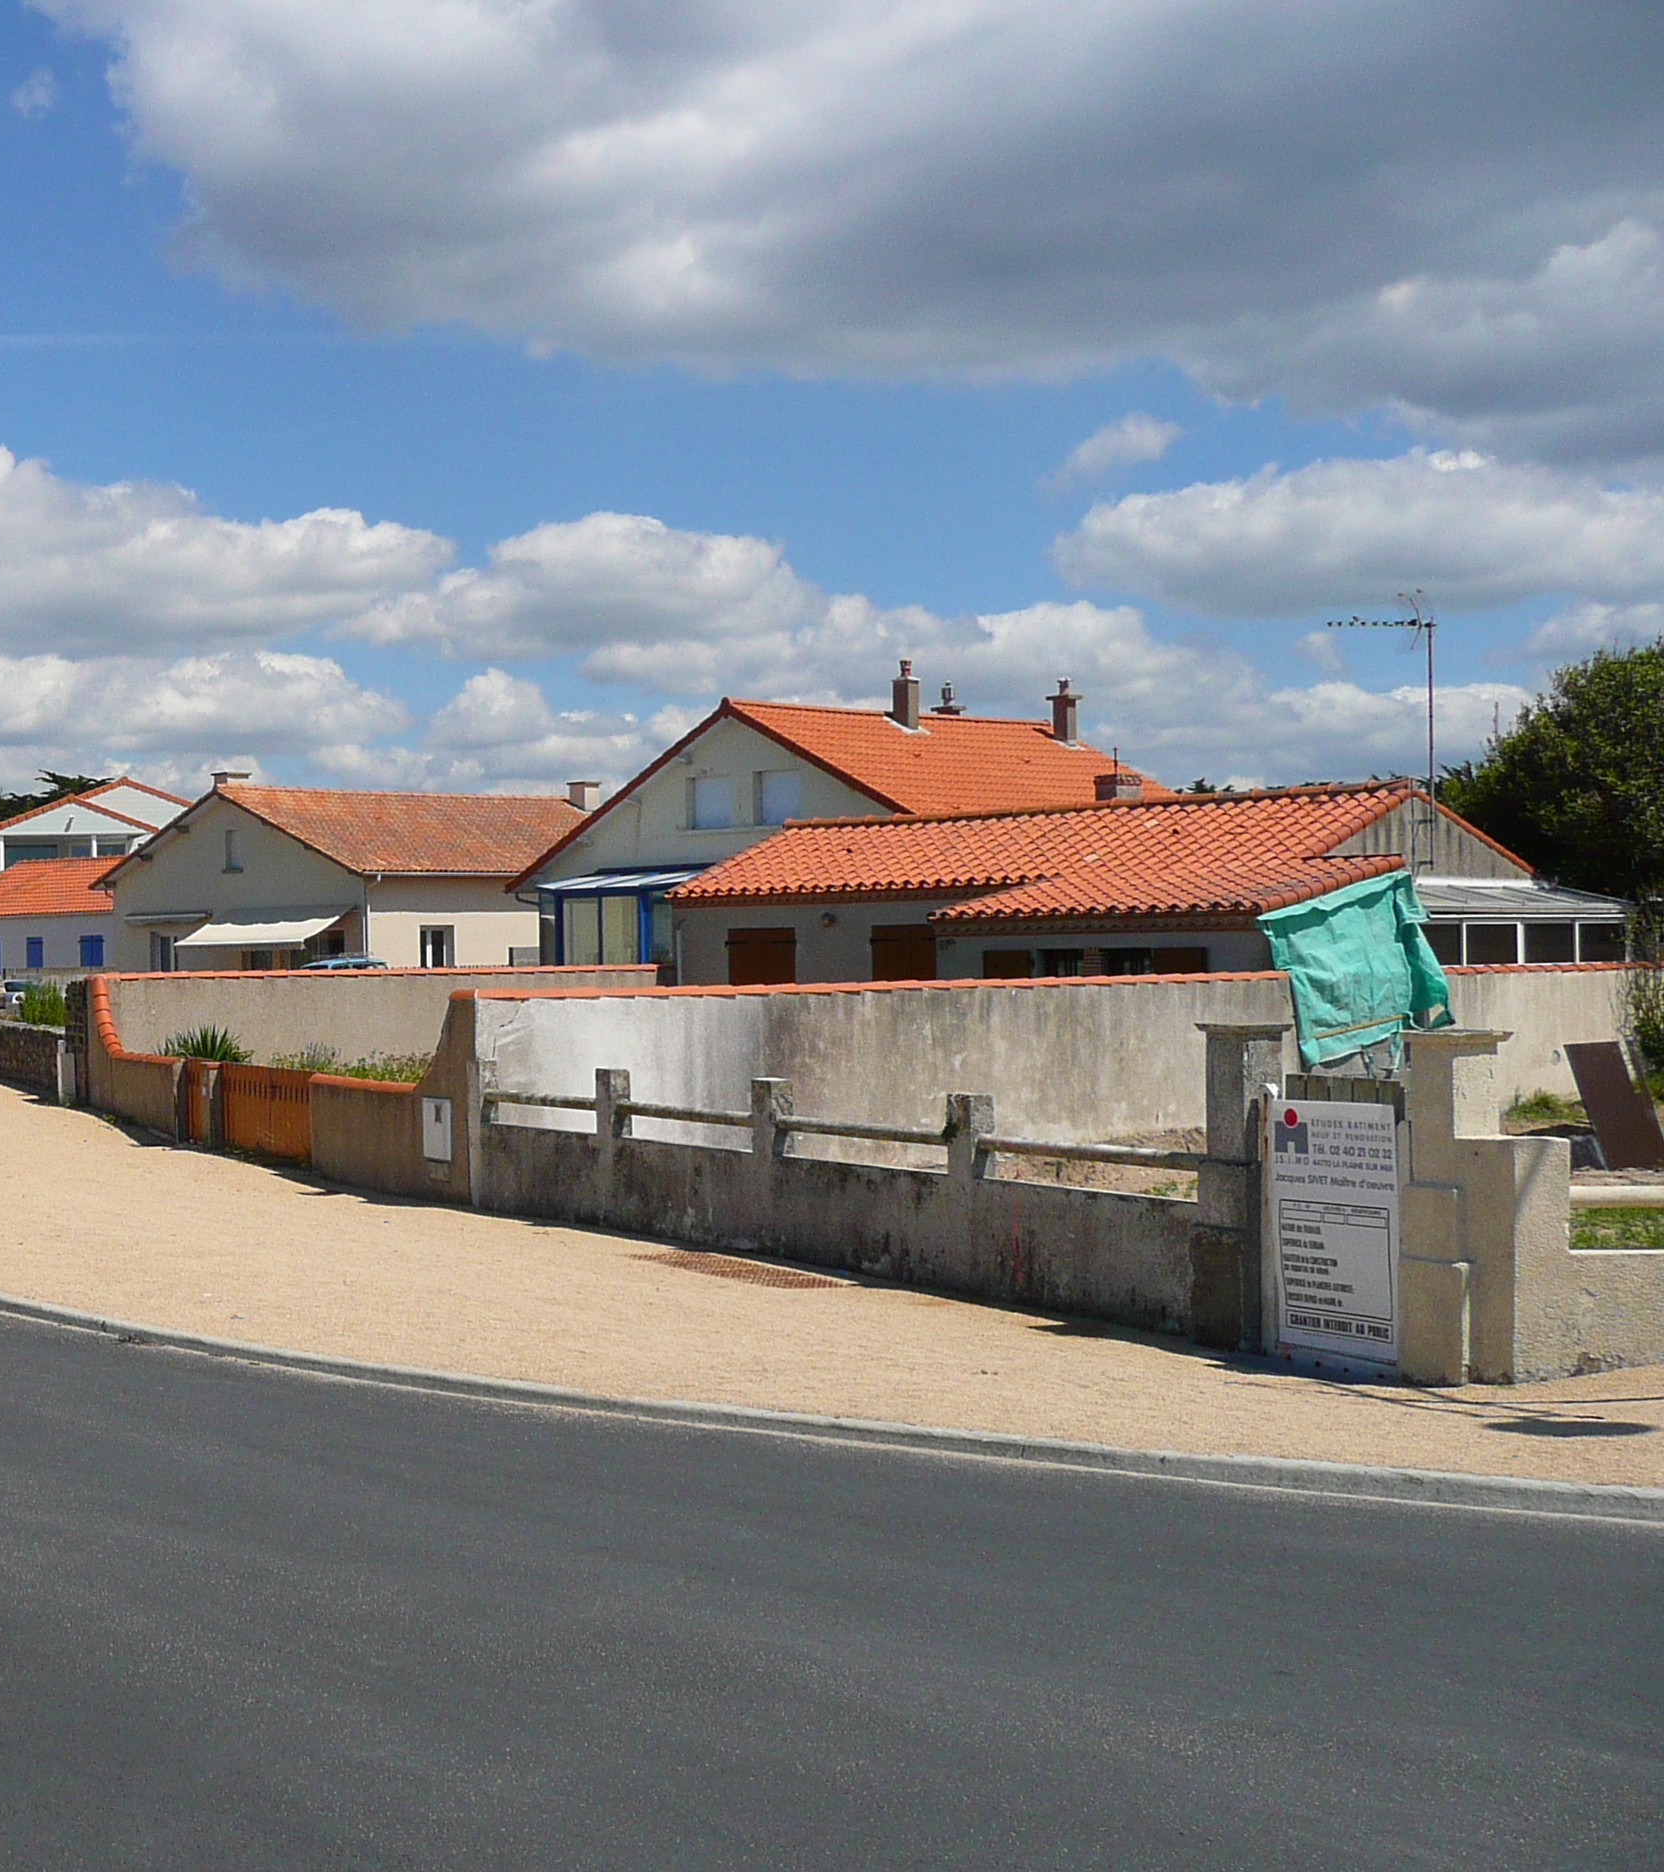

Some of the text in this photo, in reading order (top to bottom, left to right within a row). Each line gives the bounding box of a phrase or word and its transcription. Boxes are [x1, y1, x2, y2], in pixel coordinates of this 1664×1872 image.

[1329, 1145, 1341, 1156] 02
[1342, 1146, 1356, 1157] 40
[1368, 1147, 1380, 1159] 02
[1333, 1160, 1341, 1168] LA
[1341, 1160, 1364, 1170] PLAINE
[1365, 1162, 1379, 1172] SUR
[1275, 1173, 1305, 1186] Jacques
[1290, 1314, 1321, 1328] CHANTIER
[1323, 1317, 1352, 1333] INTERDIT
[1356, 1323, 1365, 1335] AU
[1367, 1325, 1389, 1339] PUBLIC
